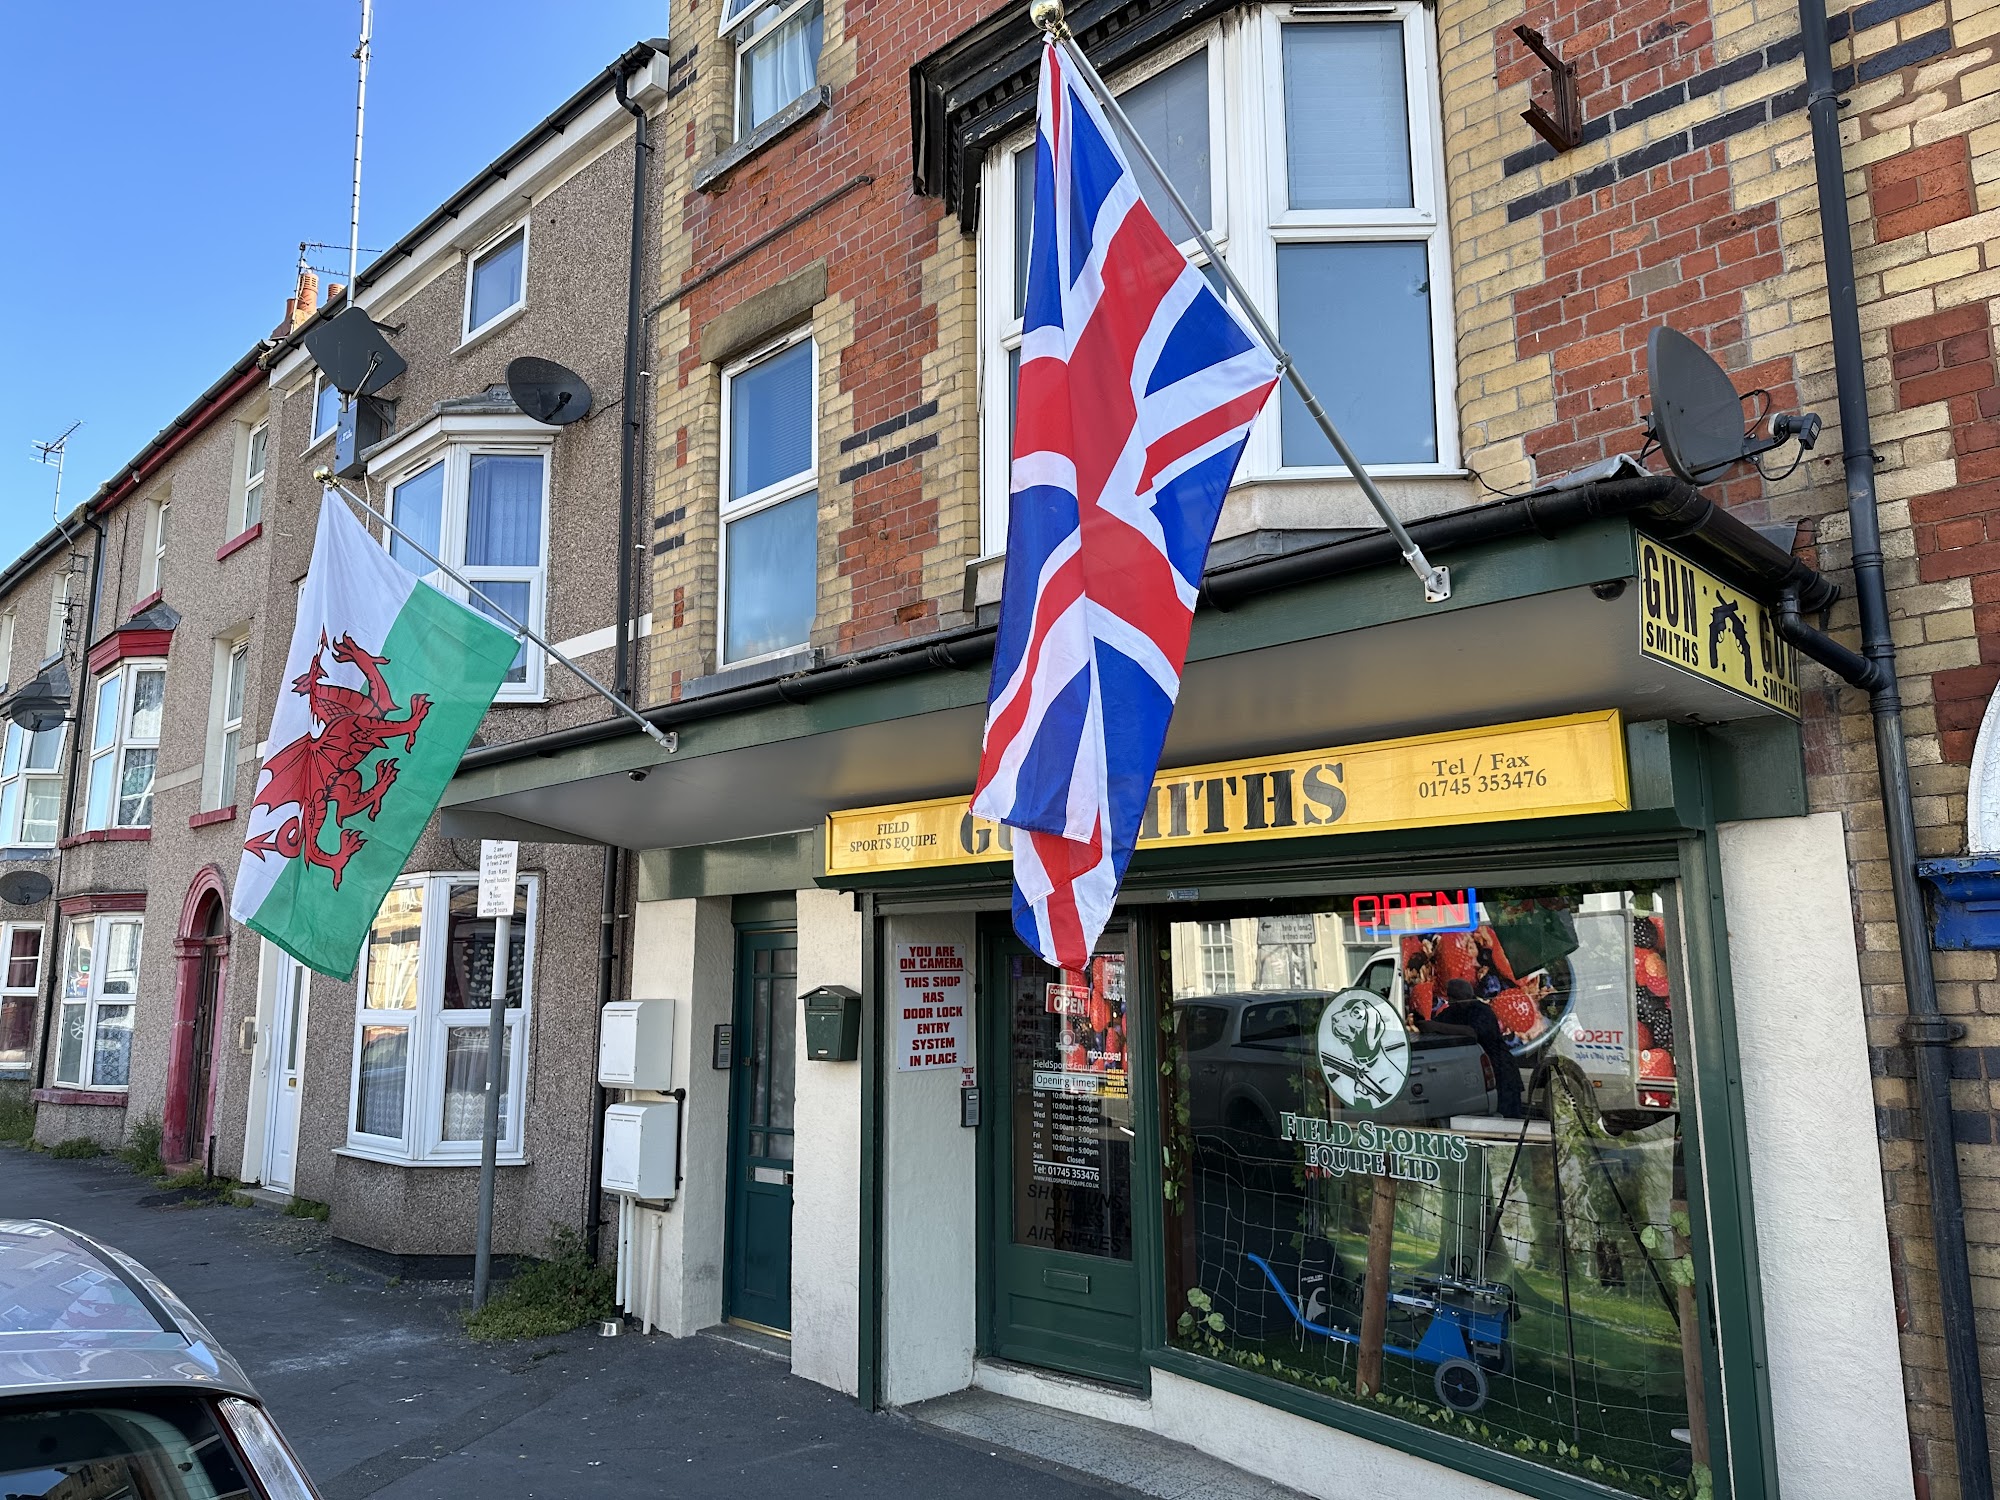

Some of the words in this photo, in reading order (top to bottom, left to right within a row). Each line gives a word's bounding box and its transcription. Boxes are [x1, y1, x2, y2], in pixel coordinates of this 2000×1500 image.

[1644, 545, 1698, 638] GUN
[1646, 621, 1698, 666] SMITHS
[1760, 610, 1799, 687] GUN
[1763, 676, 1799, 713] SMITHS
[1432, 758, 1464, 777] Tel
[1474, 754, 1483, 778] /
[1491, 752, 1530, 770] Fax
[1418, 778, 1472, 800] 01745
[1477, 769, 1548, 794] 353476
[876, 822, 910, 836] FIELD
[850, 838, 892, 853] SPORTS
[894, 834, 937, 851] EQUIPE
[1353, 890, 1466, 927] OPEN
[909, 946, 932, 957] YOU
[935, 945, 955, 957] ARE
[900, 958, 916, 970] ON
[920, 958, 964, 969] CAMERA
[905, 977, 929, 988] THIS
[933, 976, 961, 987] SHOP
[922, 992, 944, 1003] HAS
[1053, 996, 1084, 1014] OPEN
[904, 1008, 933, 1020] DOOR
[936, 1006, 963, 1018] LOCK
[917, 1022, 950, 1035] ENTRY
[912, 1037, 955, 1051] SYSTEM
[910, 1055, 922, 1067] IN
[925, 1052, 957, 1065] PLACE
[1037, 1075, 1069, 1088] Opening
[1072, 1078, 1095, 1088] Times
[1078, 1105, 1099, 1114] 5:00pm
[1078, 1115, 1099, 1124] 5:00pm
[1052, 1123, 1074, 1131] 10:00am
[1078, 1126, 1099, 1135] 7:00pm
[1078, 1136, 1099, 1145] 5:00pm
[1280, 1111, 1353, 1148] FIELD
[1358, 1120, 1469, 1162] SPORTS
[1052, 1144, 1074, 1152] 10:00am
[1078, 1147, 1099, 1156] 5:00pm
[1066, 1156, 1085, 1164] Closed
[1304, 1143, 1385, 1178] EQUIPE
[1388, 1149, 1441, 1182] LTD
[746, 1165, 754, 1182] 18
[1033, 1164, 1046, 1174] Tel:
[1048, 1166, 1070, 1178] 01745
[1072, 1169, 1099, 1181] 353476
[1026, 1225, 1056, 1242] AIR
